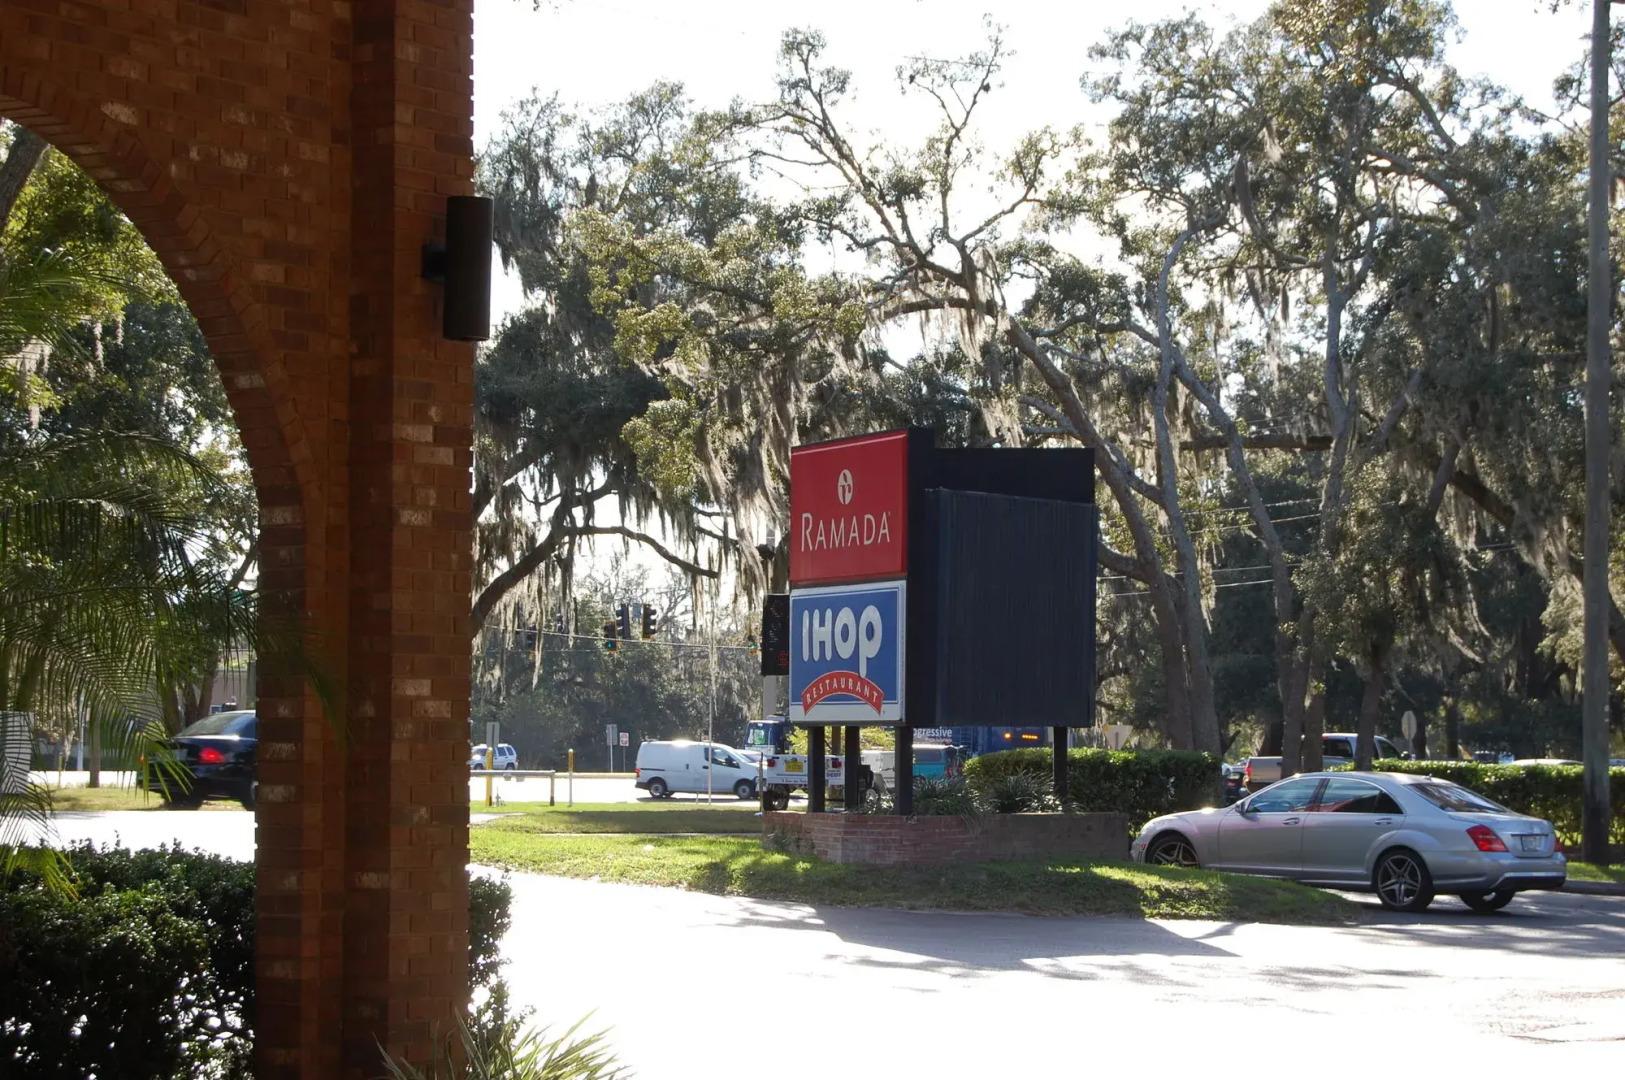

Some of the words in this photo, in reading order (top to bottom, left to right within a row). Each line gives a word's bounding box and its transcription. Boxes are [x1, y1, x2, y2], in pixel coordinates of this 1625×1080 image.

[801, 511, 890, 552] RAMADA
[806, 677, 878, 705] RESTAURANT
[913, 726, 952, 738] ogressive
